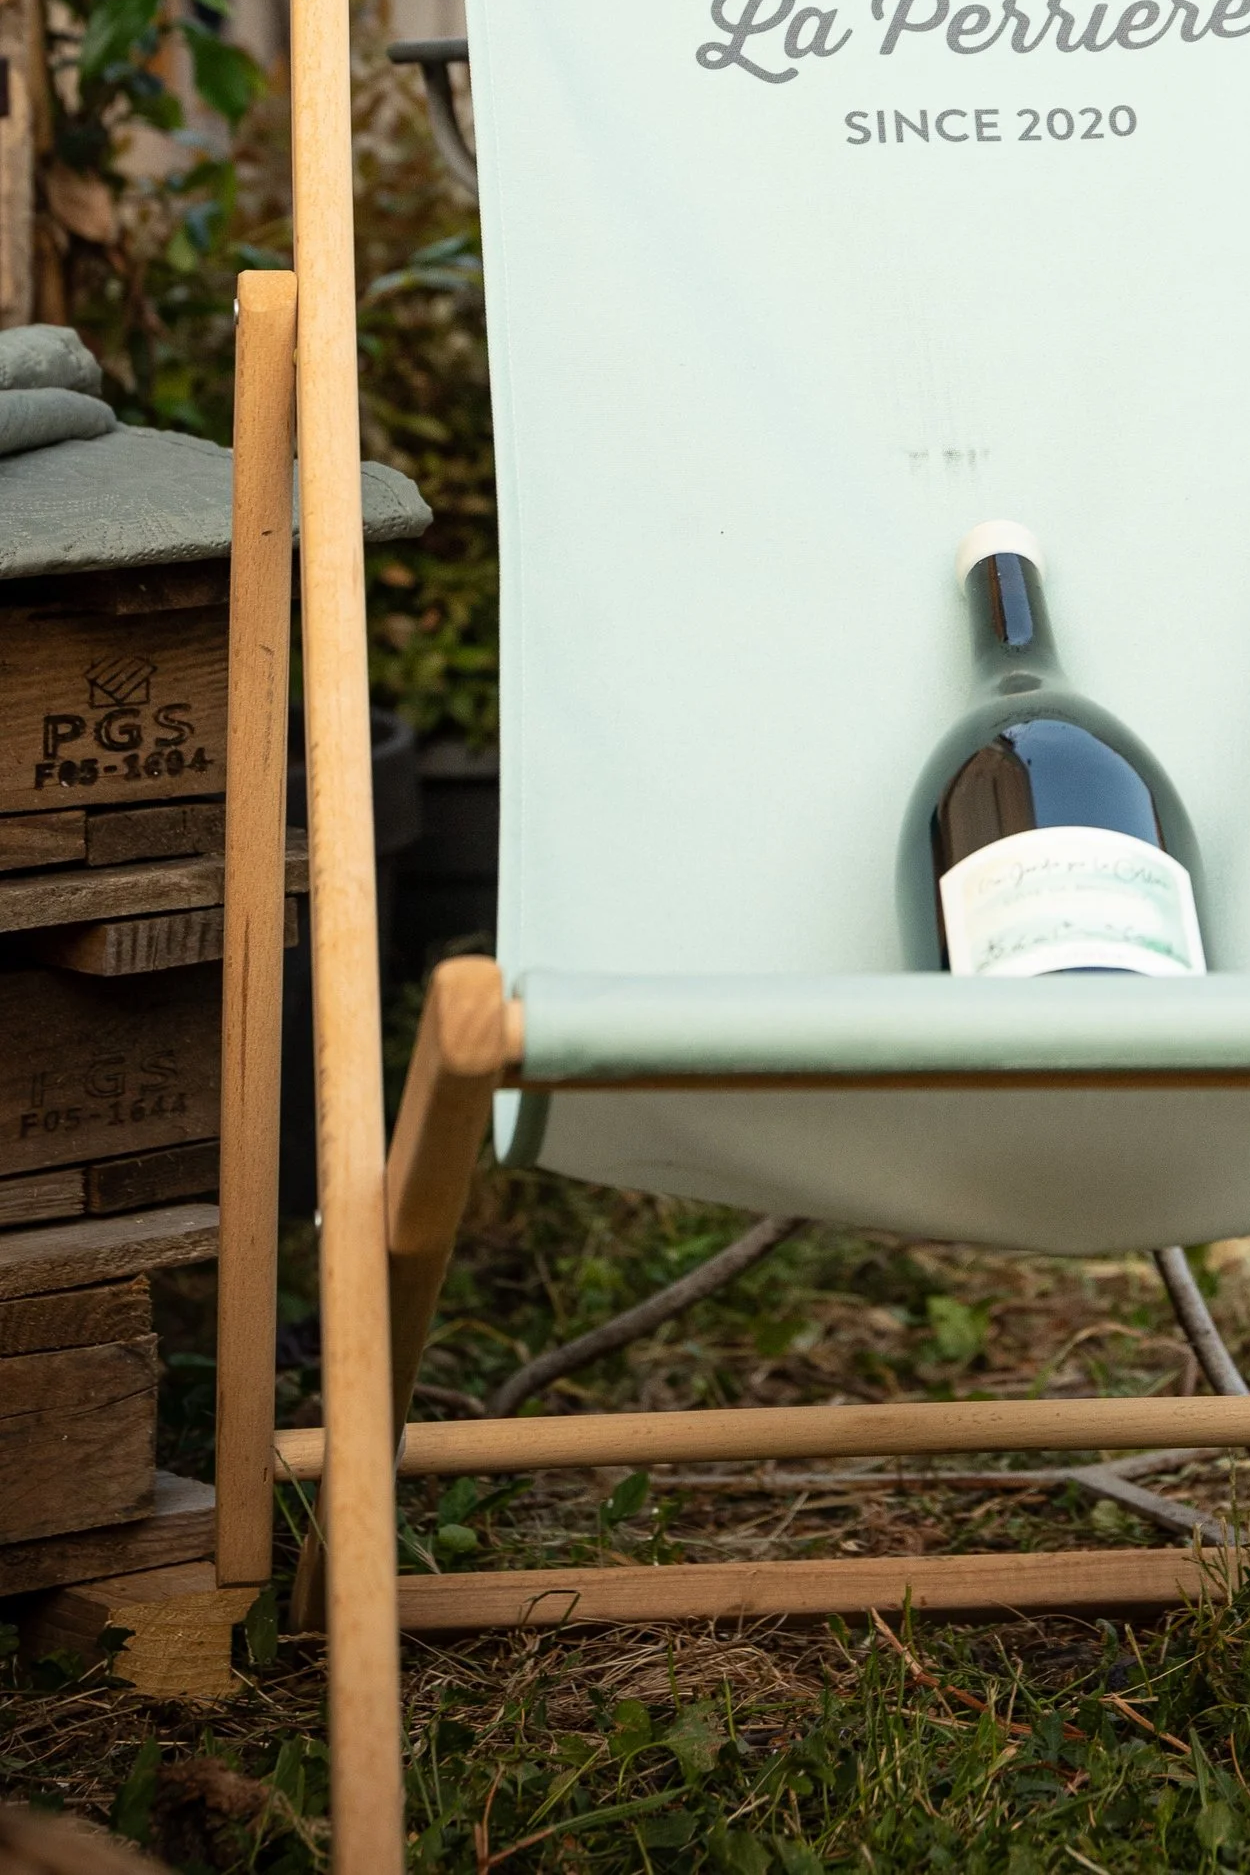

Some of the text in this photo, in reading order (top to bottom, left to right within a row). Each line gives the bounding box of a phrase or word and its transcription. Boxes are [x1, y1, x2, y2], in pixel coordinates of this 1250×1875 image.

[844, 104, 1138, 145] SINCE 2020
[43, 702, 196, 760] PGS
